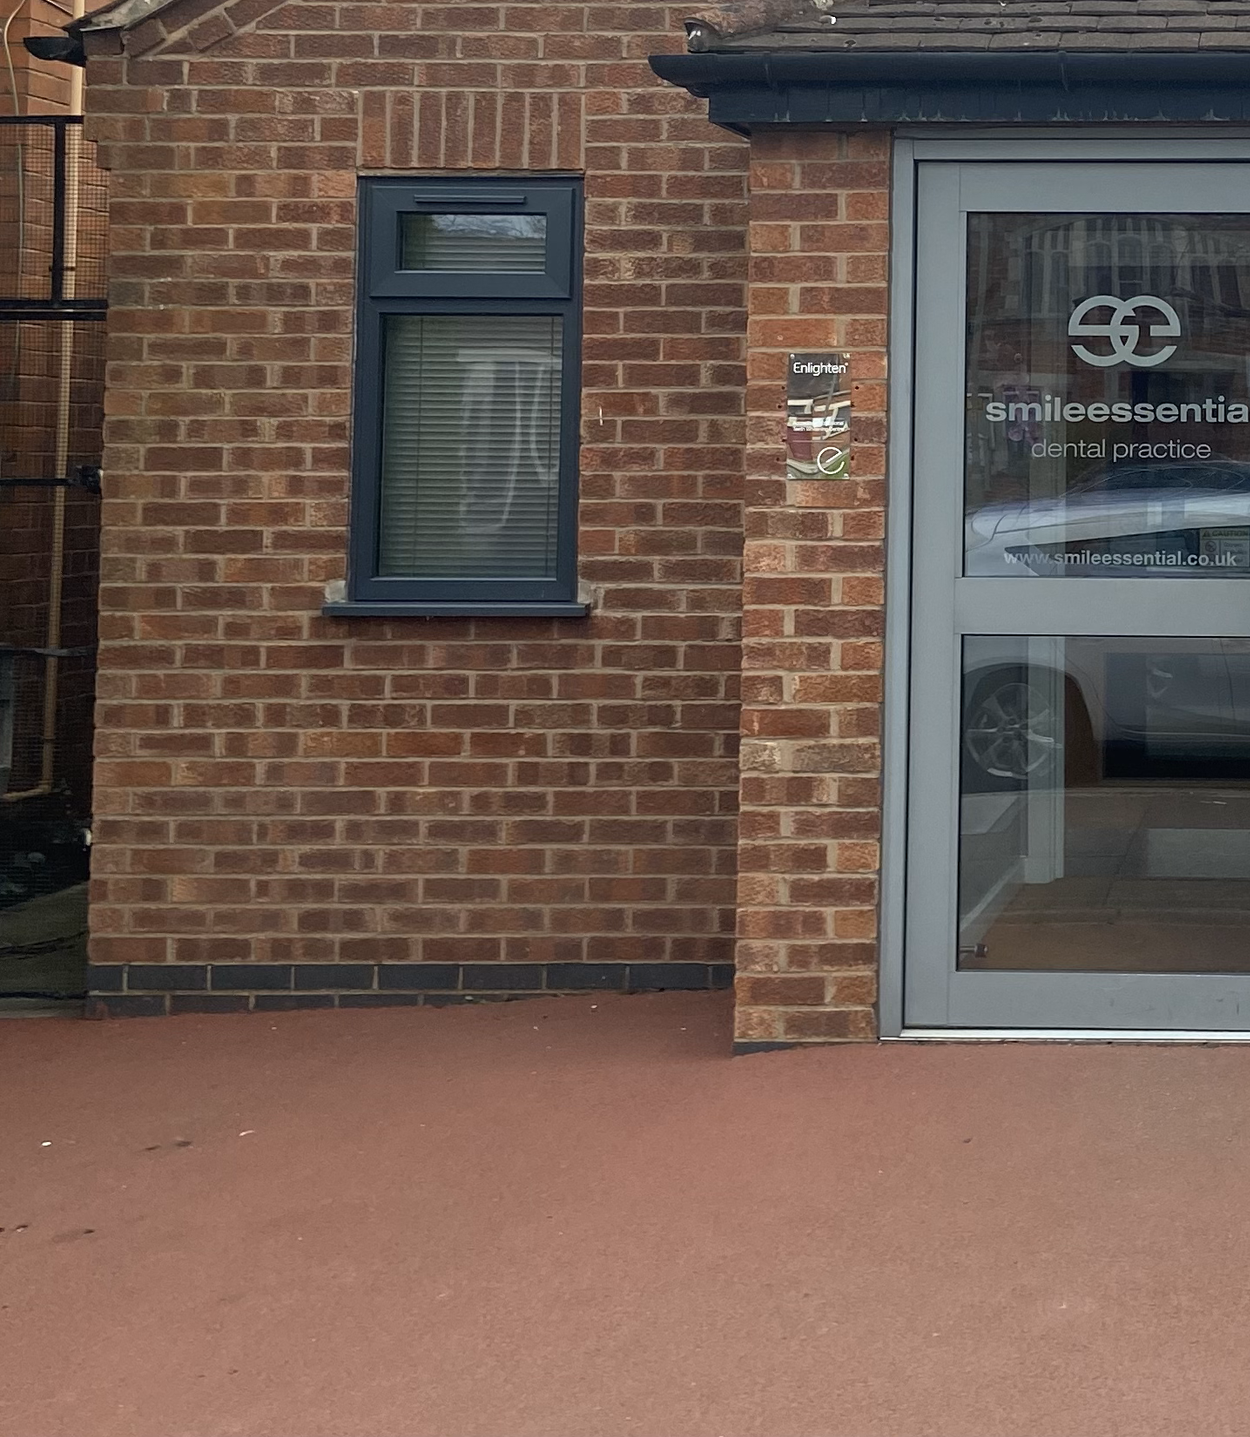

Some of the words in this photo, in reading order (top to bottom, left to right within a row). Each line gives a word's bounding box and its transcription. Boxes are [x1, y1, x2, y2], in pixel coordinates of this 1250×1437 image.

[793, 362, 846, 376] Enlighten
[1032, 438, 1106, 458] dental
[1113, 438, 1212, 462] practice
[1004, 549, 1237, 566] www.smileessential.co.uk
